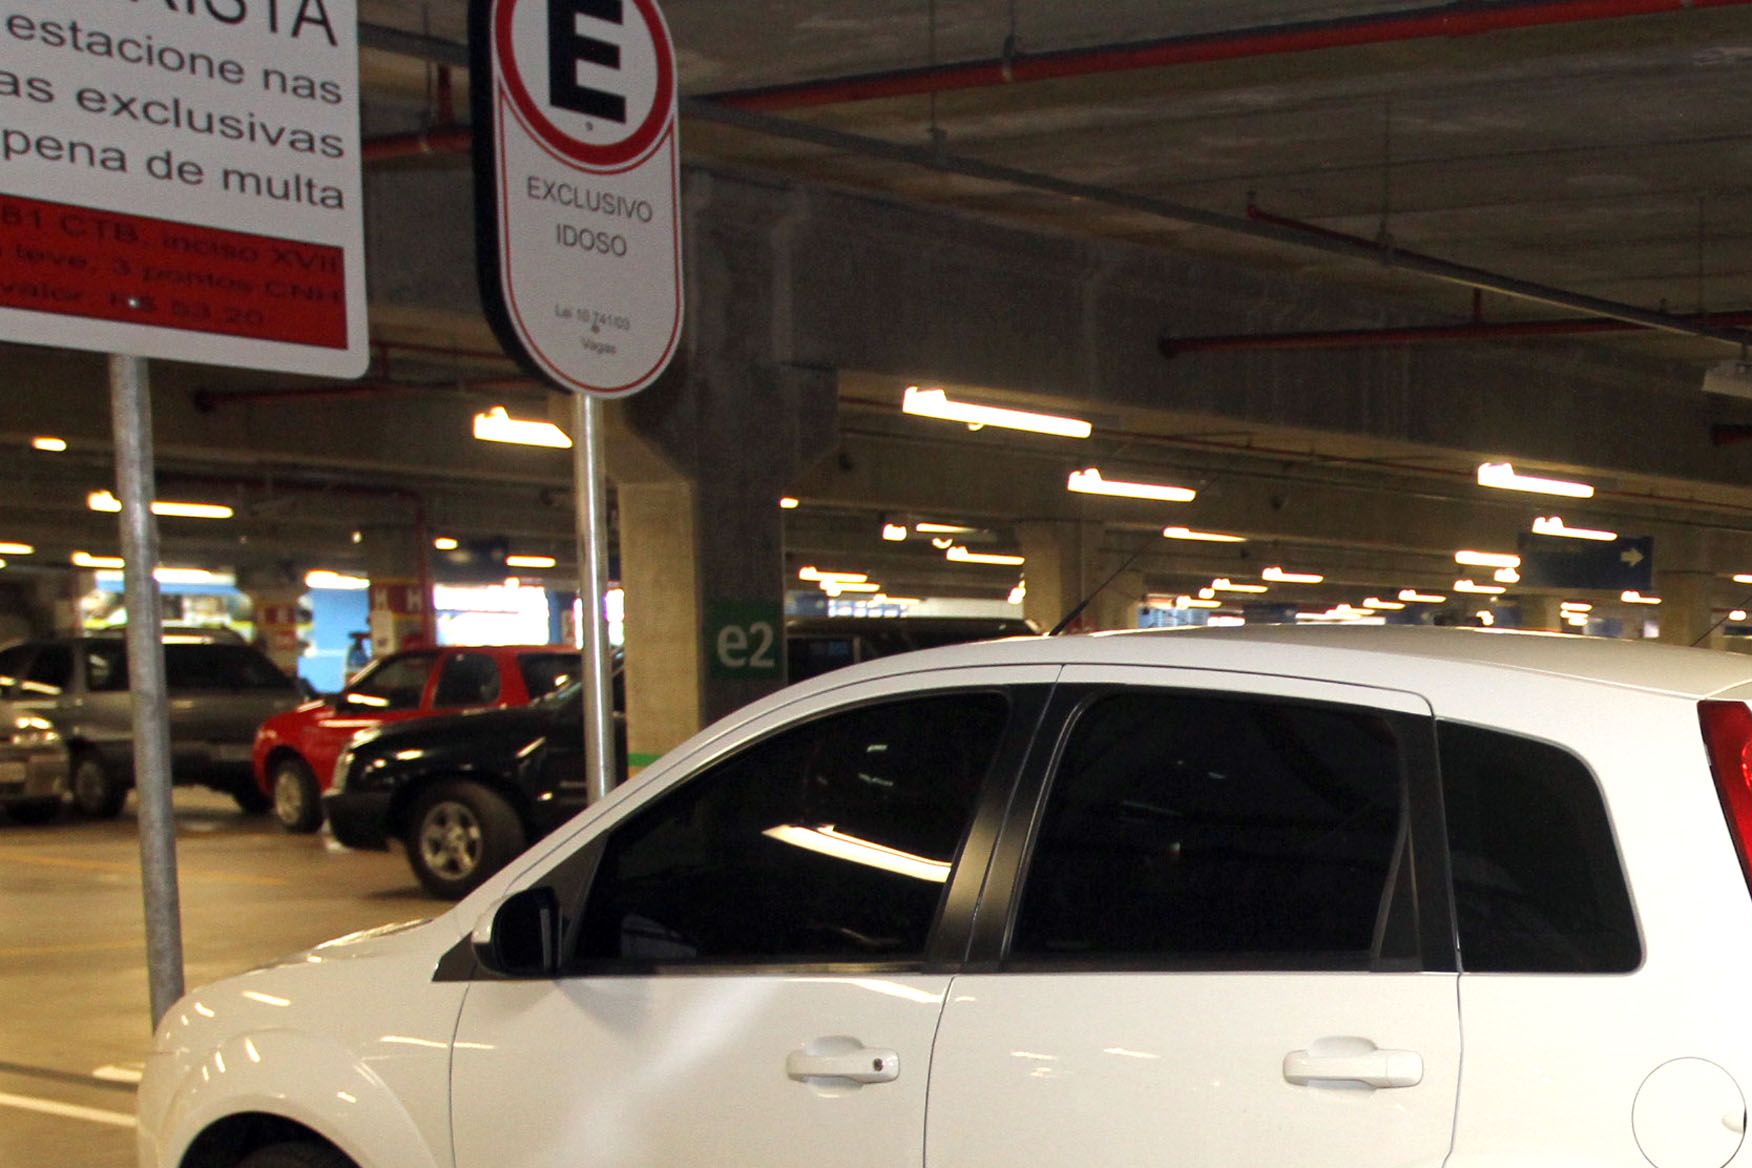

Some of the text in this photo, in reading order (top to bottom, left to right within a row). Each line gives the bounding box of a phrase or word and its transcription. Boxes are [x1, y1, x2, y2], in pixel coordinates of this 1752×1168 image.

[6, 14, 342, 105] estacione nas
[548, 0, 626, 124] E
[76, 86, 345, 158] exclusivas
[2, 128, 344, 209] pena de multa
[527, 176, 653, 223] EXCLUSIVO
[556, 223, 627, 257] IDOSO
[717, 621, 775, 668] e2
